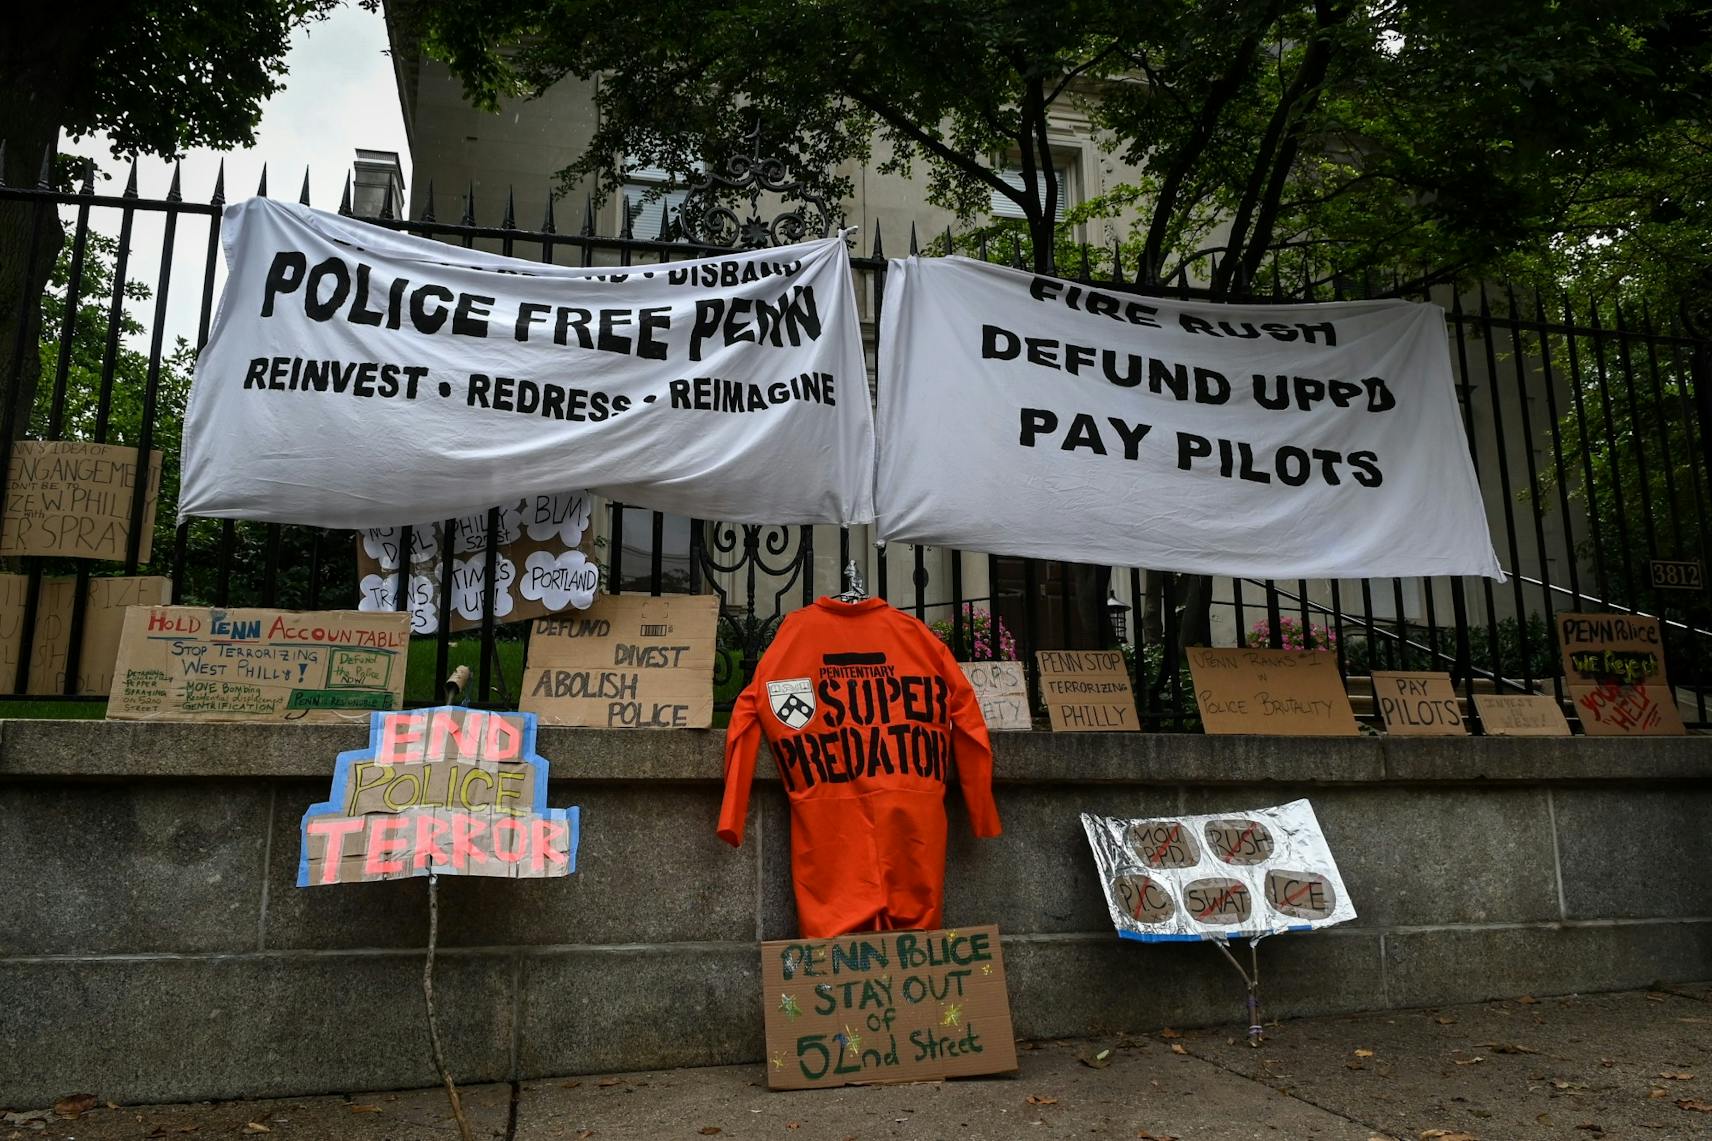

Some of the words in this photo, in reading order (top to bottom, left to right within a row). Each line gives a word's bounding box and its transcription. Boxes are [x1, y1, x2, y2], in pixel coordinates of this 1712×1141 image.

[261, 251, 495, 337] POLICE
[514, 302, 672, 362] FREE
[688, 285, 822, 362] PENN
[1029, 276, 1163, 329] FIRE
[1178, 312, 1336, 347] RUSH
[981, 323, 1231, 406] DEFUND
[1251, 374, 1396, 413] UPPD
[244, 356, 429, 400] REINVEST
[467, 374, 631, 422] REDRESS
[669, 371, 835, 413] REIMAGINE
[1019, 408, 1152, 461] PAY
[1175, 431, 1383, 488] PILOTS
[7, 457, 160, 492] ENGANGEMET
[41, 482, 59, 490] BE
[534, 495, 583, 527] BLM
[532, 566, 597, 592] PORTLAND
[1654, 564, 1700, 585] 3812
[210, 610, 260, 639] PENN
[268, 615, 406, 648] ACCOUNTABLE
[536, 618, 610, 638] DEFUND
[1563, 619, 1614, 645] PENN
[182, 659, 227, 676] WEST
[212, 643, 318, 664] TERRORIZING
[614, 643, 690, 668] DIVEST
[1041, 652, 1084, 673] PENN
[1087, 651, 1121, 671] STOP
[532, 670, 638, 700] ABOLISH
[818, 665, 895, 679] PENITENTIARY
[818, 675, 949, 728] SUPER
[1048, 680, 1128, 695] TERRORIZING
[1396, 679, 1427, 697] PAY
[182, 701, 275, 711] GENTRIFICATION
[608, 702, 689, 728] POLICE
[1061, 705, 1127, 727] PHILLY
[1199, 690, 1249, 715] POLICE
[1254, 691, 1333, 718] BRUTALITY
[1382, 697, 1461, 726] PILOTS
[380, 713, 520, 765] END
[348, 761, 527, 817] POLICE
[307, 813, 567, 883] TERROR
[1209, 828, 1270, 856] RUSH
[1188, 889, 1247, 914] SWAT
[780, 938, 889, 981] PENN
[896, 933, 993, 970] POLICE
[815, 976, 893, 1016] STAY
[902, 969, 972, 1004] OUT
[797, 1033, 900, 1080] 52nd
[909, 1022, 984, 1063] Street
